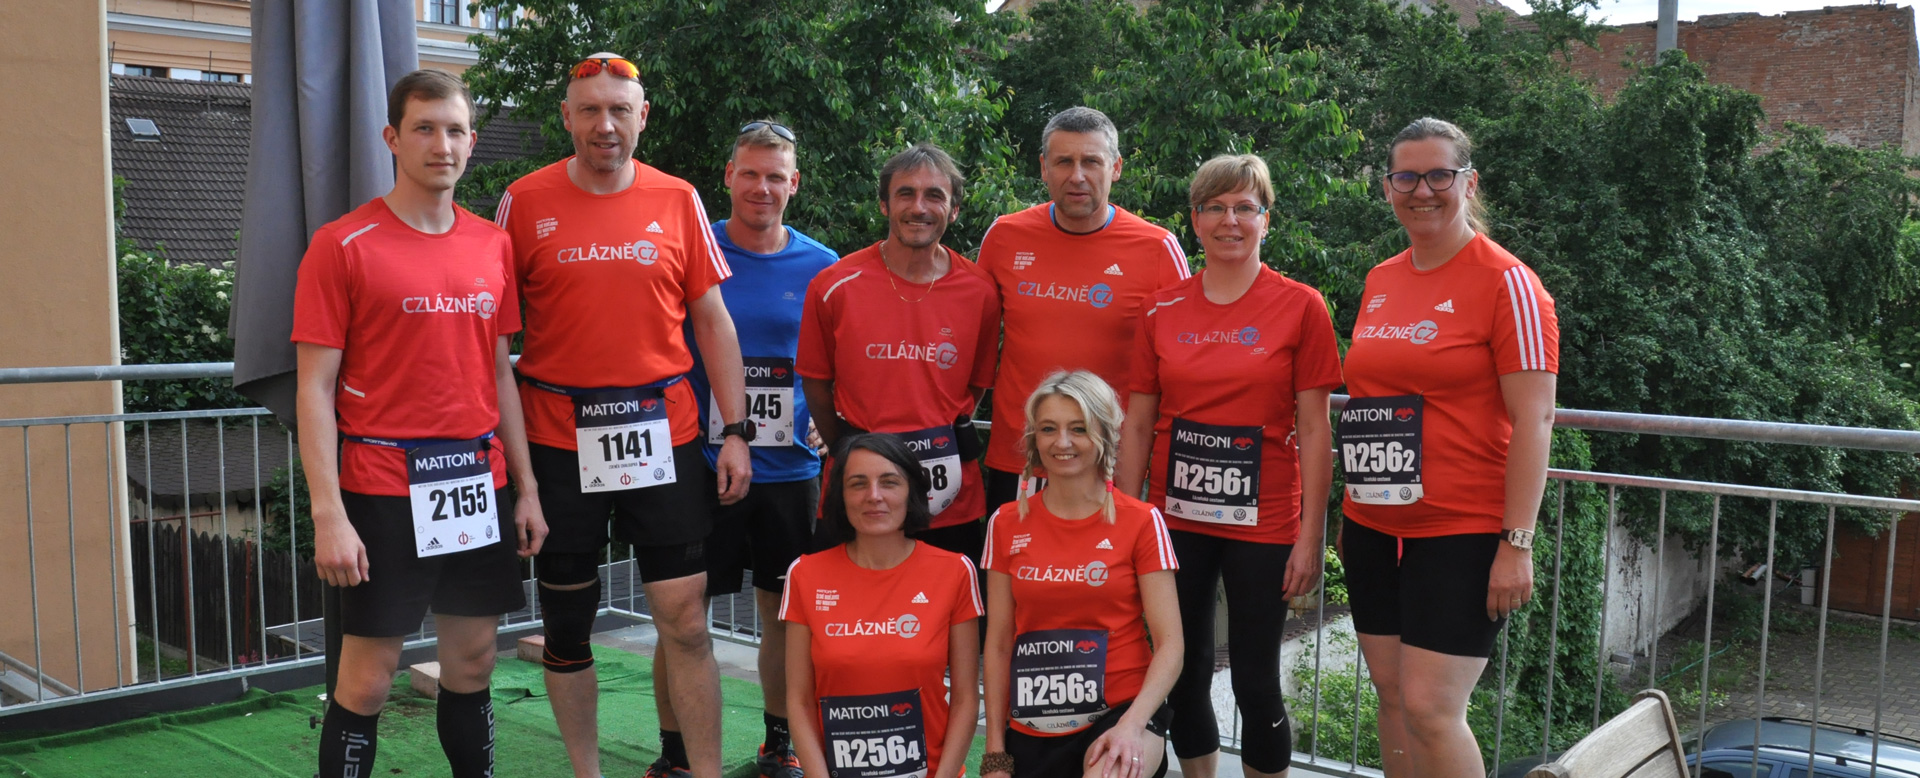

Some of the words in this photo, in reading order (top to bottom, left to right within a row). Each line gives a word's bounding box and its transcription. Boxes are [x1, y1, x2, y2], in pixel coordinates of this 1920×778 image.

[582, 400, 639, 417] MATTONI
[1340, 407, 1392, 423] MATTONI
[598, 428, 653, 461] 1141
[1176, 429, 1230, 448] MATTONI
[415, 451, 475, 472] MATTONI
[1343, 441, 1415, 473] R2562
[1173, 460, 1251, 496] R2561
[429, 482, 488, 521] 2155
[1017, 640, 1073, 657] MATTONI
[1017, 673, 1098, 707] R2563
[829, 704, 889, 720] MATTONI
[832, 735, 921, 768] R2564
